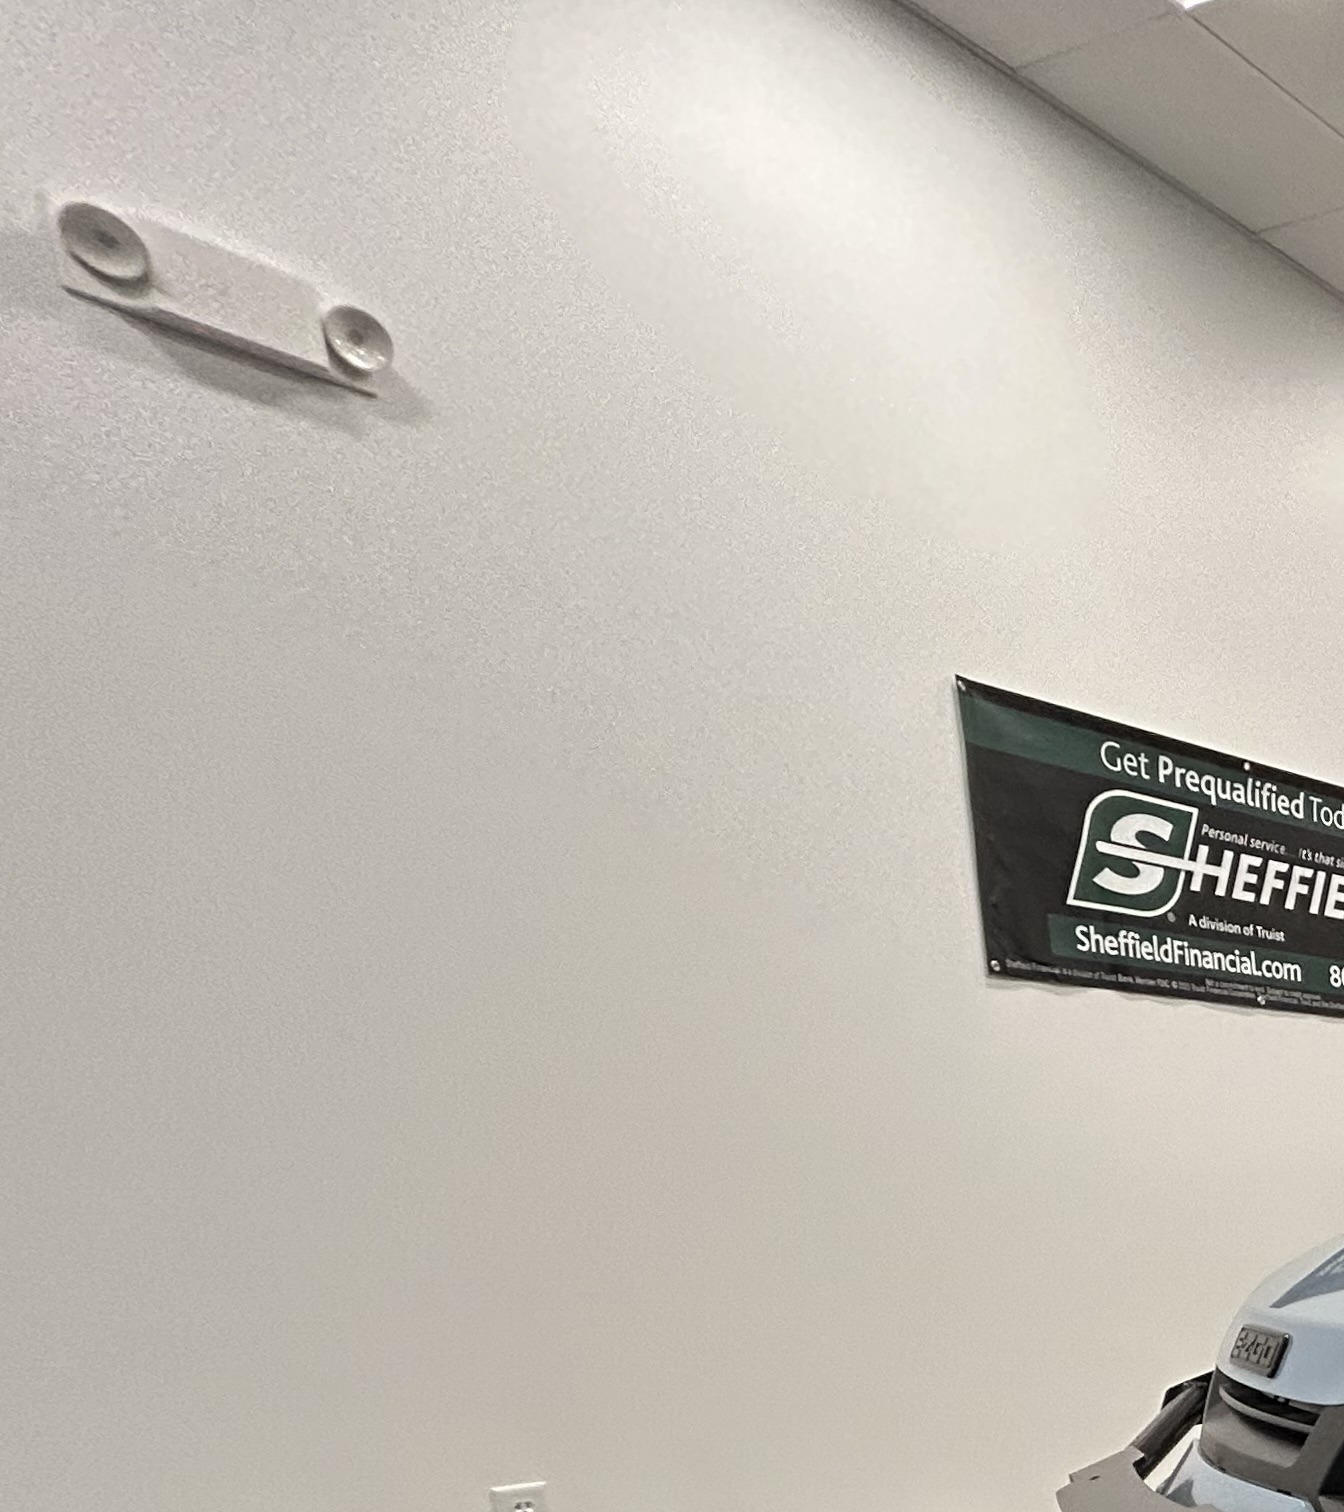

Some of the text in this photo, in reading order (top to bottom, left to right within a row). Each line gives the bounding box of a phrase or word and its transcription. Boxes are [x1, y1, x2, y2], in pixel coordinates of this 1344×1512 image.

[1100, 741, 1150, 780] Get
[1158, 755, 1305, 819] Prequalified
[1201, 823, 1248, 848] Personal
[1314, 851, 1335, 867] that
[1074, 924, 1303, 983] SheffieldFinancial.com
[1188, 913, 1286, 943] A division of Truist
